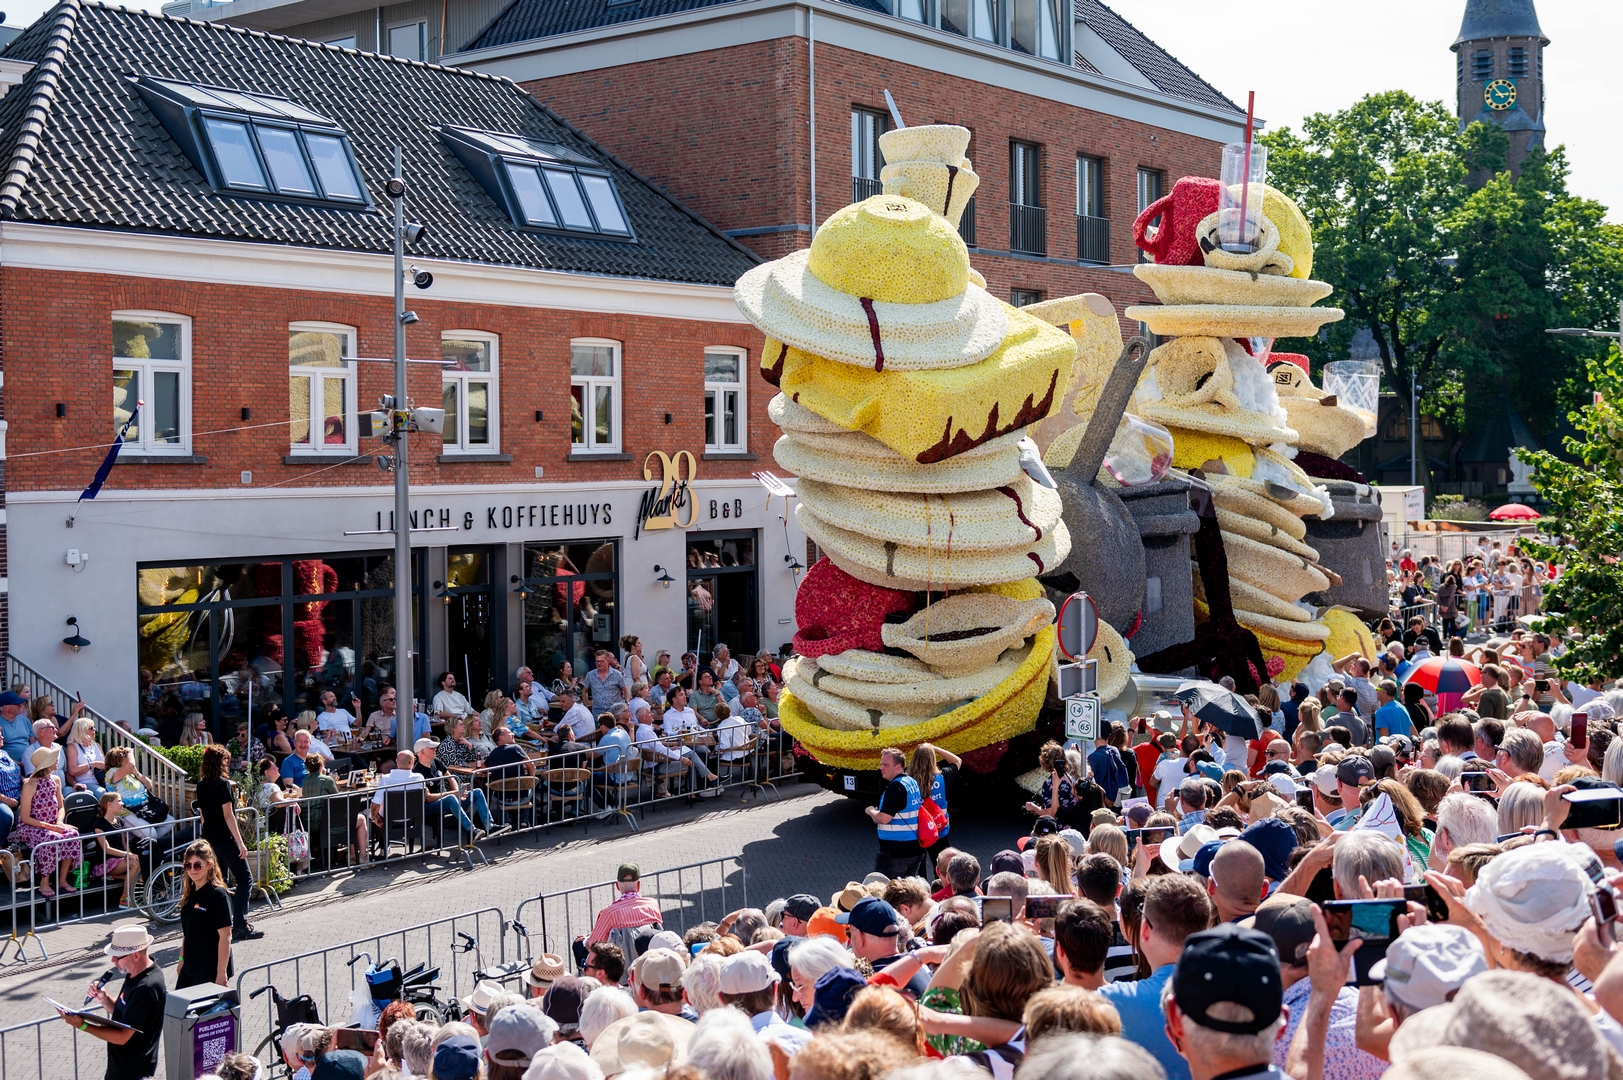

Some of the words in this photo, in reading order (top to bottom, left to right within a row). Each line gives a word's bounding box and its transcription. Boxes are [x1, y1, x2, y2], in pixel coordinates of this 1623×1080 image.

[643, 450, 699, 530] 28
[464, 511, 474, 530] &
[487, 503, 612, 529] KOFFIEHUYS
[634, 480, 687, 541] Markt
[709, 498, 743, 519] B&B
[1072, 706, 1082, 714] 14
[1080, 723, 1090, 731] 65
[845, 777, 855, 786] 13
[198, 1020, 230, 1033] PUBLIEKSJURY
